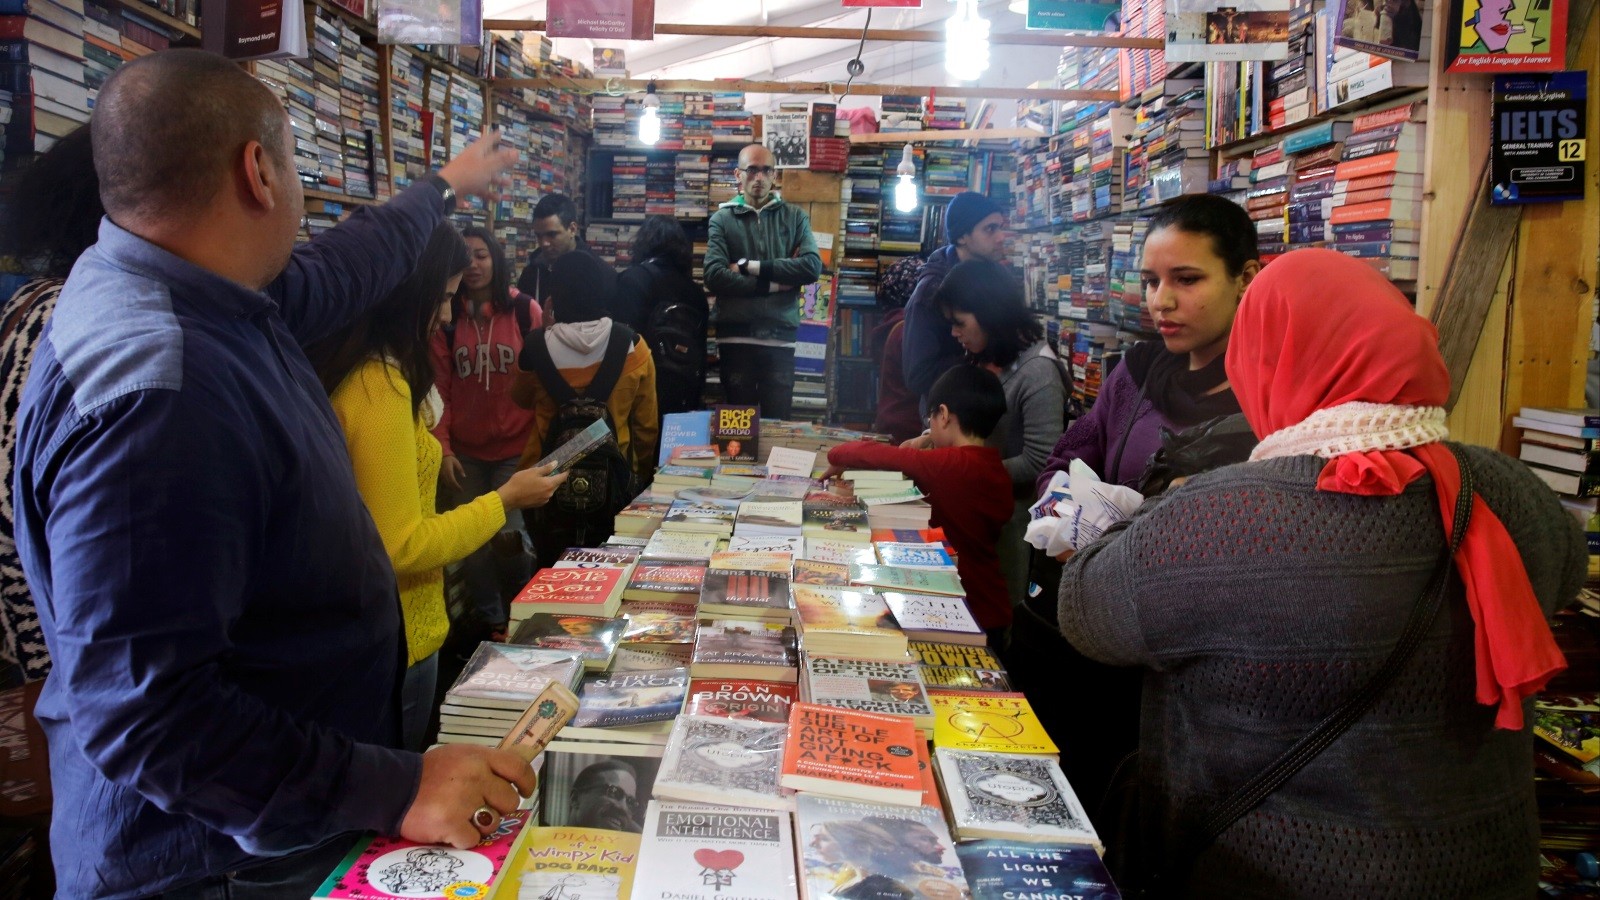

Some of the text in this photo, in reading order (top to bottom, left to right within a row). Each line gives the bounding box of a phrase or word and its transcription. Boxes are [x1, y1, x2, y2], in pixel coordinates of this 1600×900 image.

[238, 32, 276, 44] Raymond Murphy
[1456, 56, 1467, 66] for
[1468, 56, 1491, 66] English
[1492, 56, 1522, 66] Language
[1504, 92, 1566, 102] Cambridge English
[1500, 109, 1578, 140] IELTS
[1560, 142, 1580, 159] 12
[455, 343, 515, 379] GAP
[720, 409, 750, 419] RICH
[720, 419, 751, 429] DAD
[539, 570, 608, 581] Me
[750, 570, 787, 579] kafka
[526, 584, 603, 595] You
[908, 642, 988, 656] UNLIMITED
[813, 664, 915, 673] HISTORY
[479, 672, 552, 683] GREAT
[853, 670, 917, 679] TIME
[470, 678, 544, 689] GATSB
[593, 677, 685, 688] SHACK
[720, 685, 769, 693] DAN
[699, 691, 791, 704] BROWN
[704, 702, 779, 715] ORIGIN
[817, 698, 928, 710] STEPHEN
[934, 699, 1020, 708] HABIT
[800, 712, 845, 720] THE
[800, 718, 889, 736] SUBTLE
[800, 726, 885, 744] ART OF
[800, 733, 848, 747] NOT
[799, 741, 884, 761] GIVING
[800, 750, 816, 760] A
[803, 761, 872, 774] COUNTERINTUITIVE
[876, 771, 914, 779] APPROACH
[804, 765, 832, 773] LIVING
[797, 769, 904, 788] MARK MANSON
[987, 783, 1034, 792] Utopia
[851, 802, 938, 816] MOUNTAIN
[828, 807, 932, 823] BETWEEN US
[666, 814, 773, 829] EMOTIONAL
[553, 832, 620, 844] DIARY
[665, 826, 772, 839] INTELLIGENCE
[528, 847, 635, 863] Wimpy Kid
[1027, 852, 1062, 860] THE
[535, 862, 619, 874] DOG DAYS
[1002, 863, 1059, 873] LIGHT
[1022, 878, 1052, 887] WE
[661, 892, 705, 900] DANIEL
[1002, 892, 1083, 900] CANNOT
